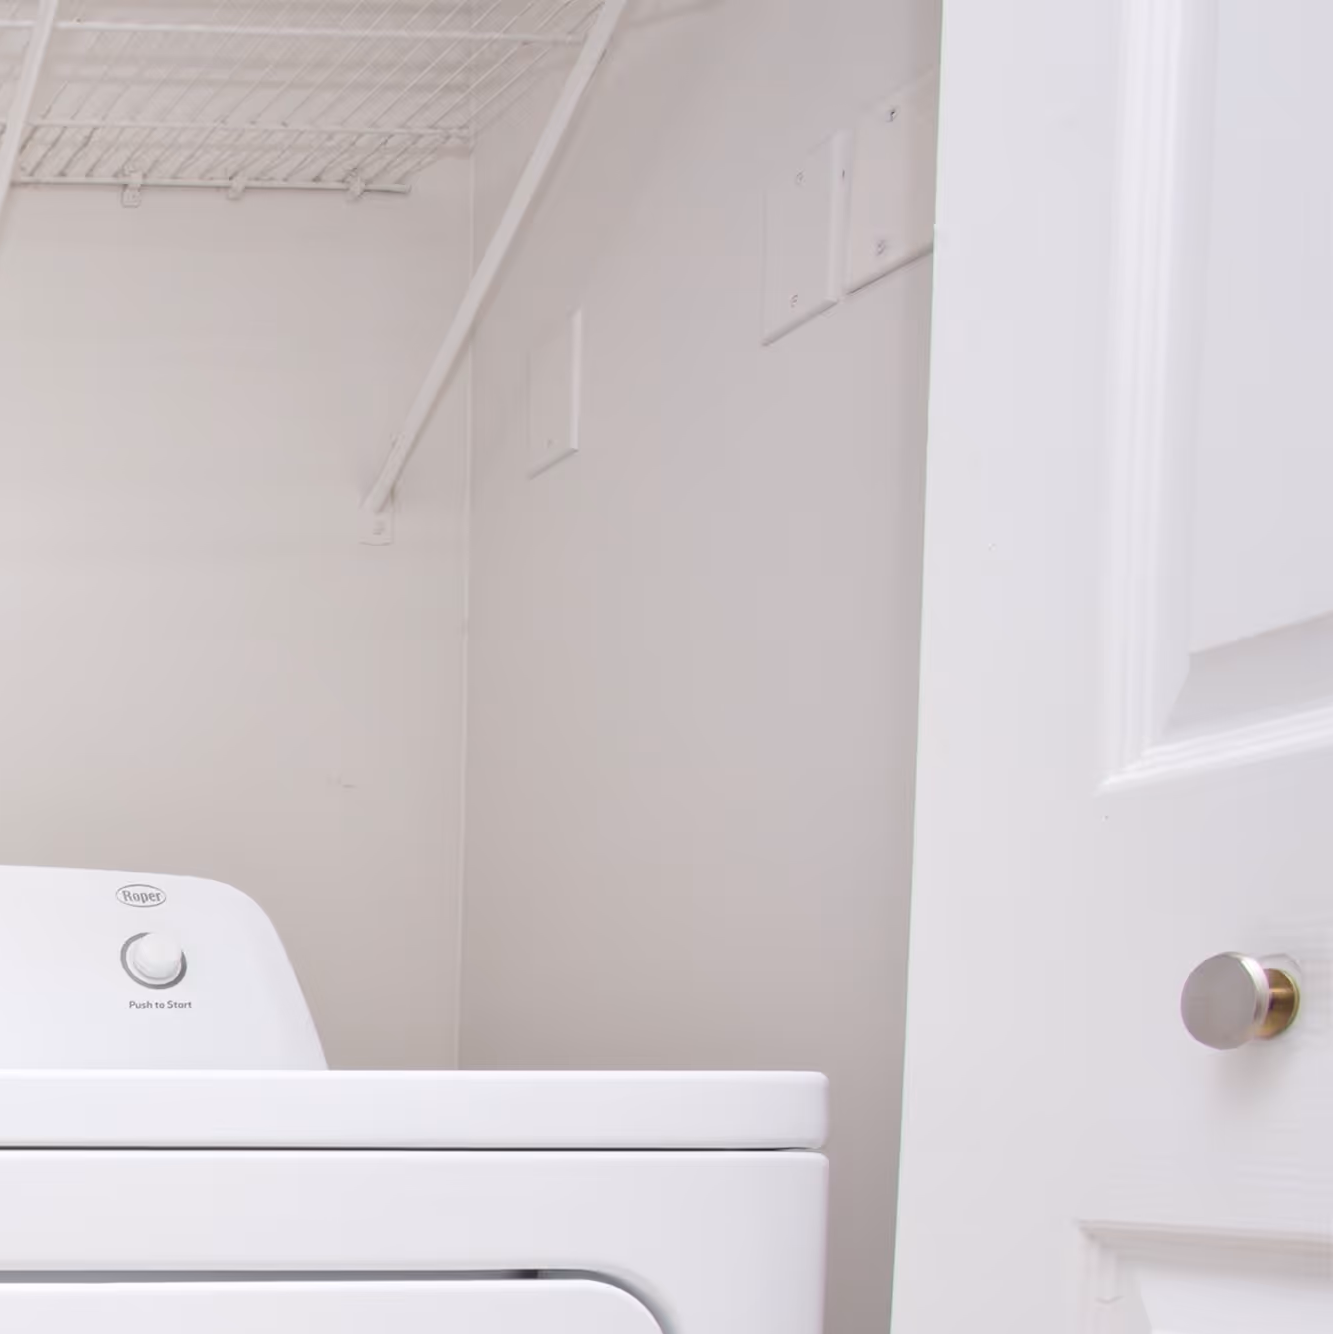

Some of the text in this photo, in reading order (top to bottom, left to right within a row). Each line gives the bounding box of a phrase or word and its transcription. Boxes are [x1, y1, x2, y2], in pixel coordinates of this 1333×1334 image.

[121, 889, 162, 903] Roper
[128, 1000, 193, 1009] Push to Start
